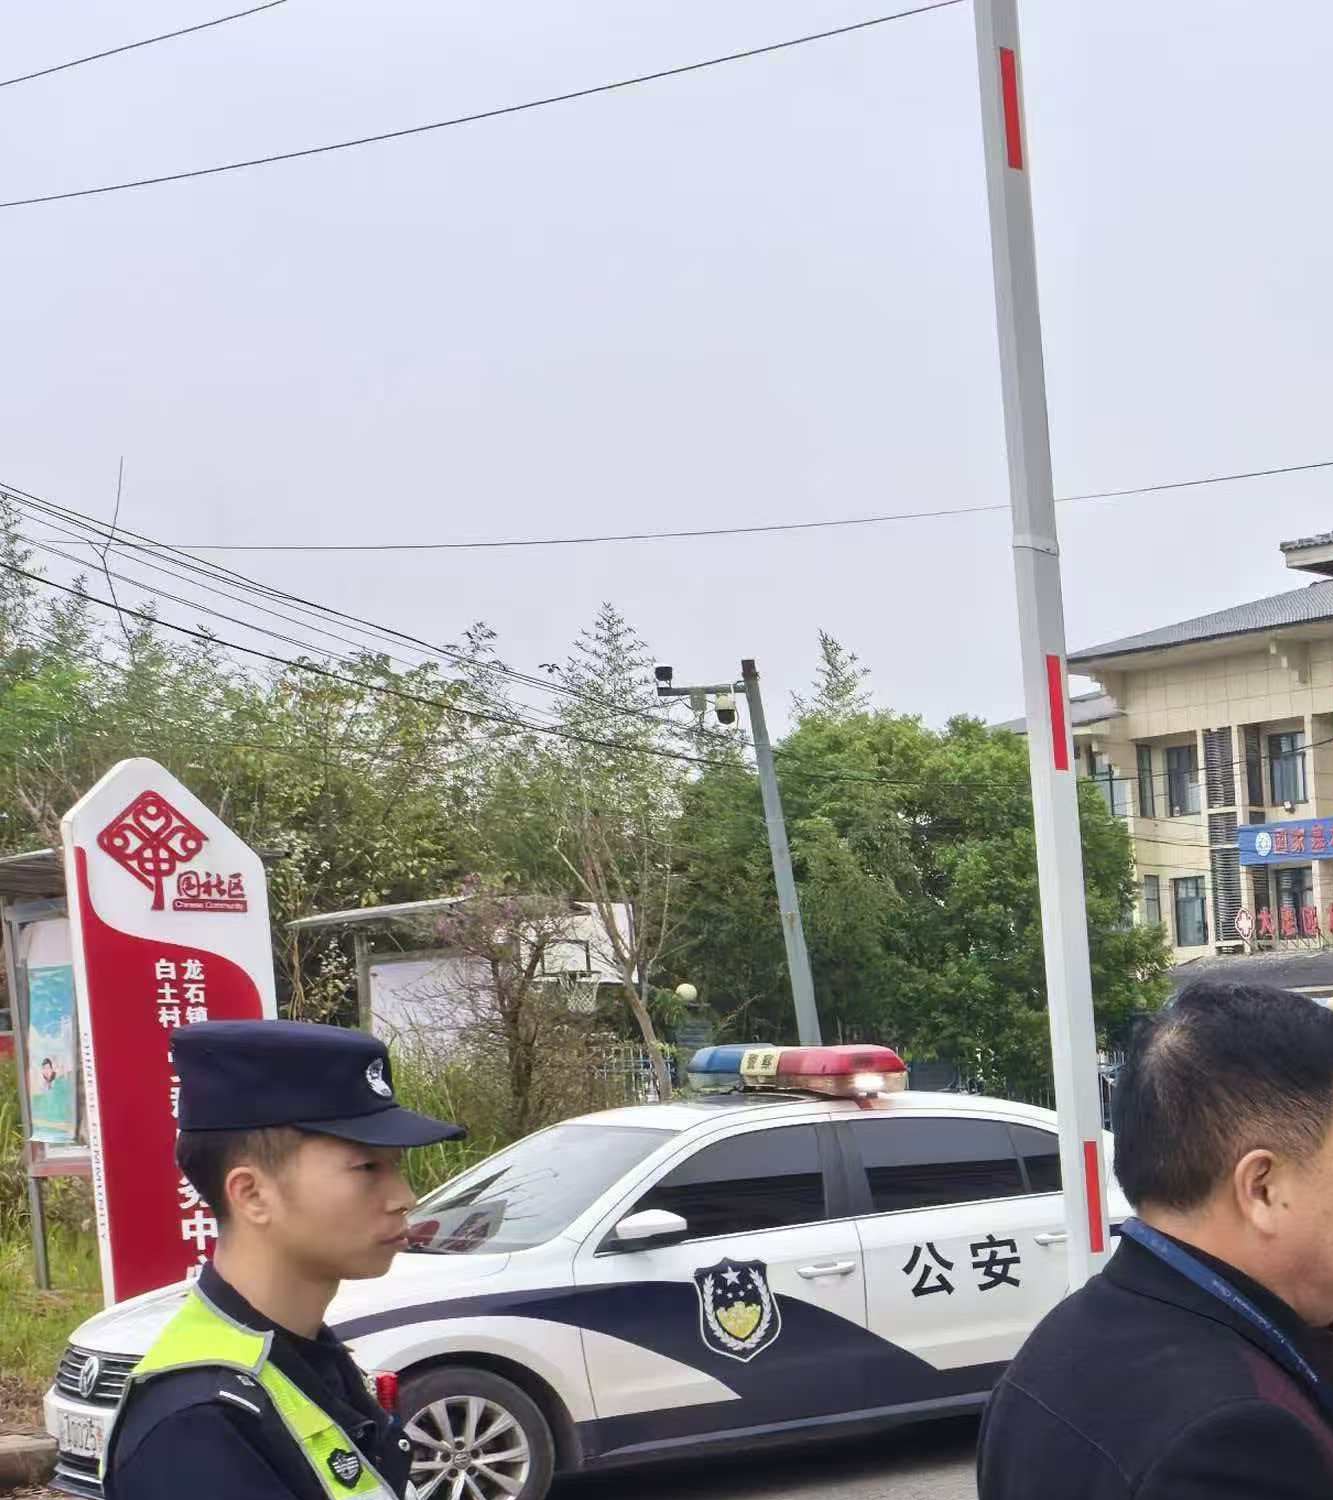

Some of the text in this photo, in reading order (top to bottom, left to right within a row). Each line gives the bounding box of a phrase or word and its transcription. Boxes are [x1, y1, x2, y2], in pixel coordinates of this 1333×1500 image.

[154, 958, 182, 1028] 白土村
[902, 1233, 1023, 1299] 公安
